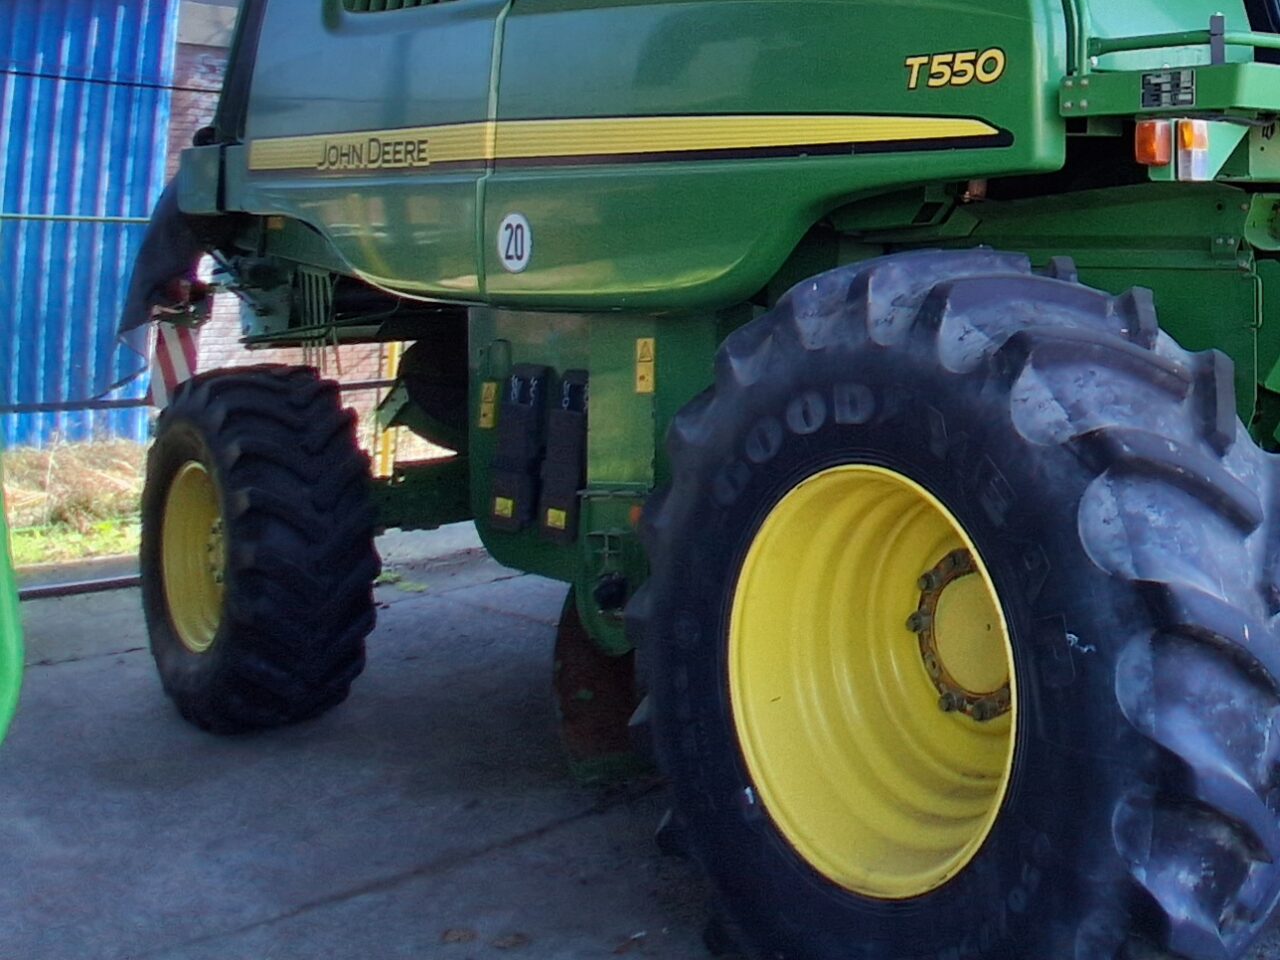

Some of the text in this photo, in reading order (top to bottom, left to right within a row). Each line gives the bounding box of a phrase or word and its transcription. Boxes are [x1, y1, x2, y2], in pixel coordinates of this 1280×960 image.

[904, 46, 1006, 90] T550
[317, 138, 428, 166] JOHN DEERE
[505, 223, 524, 261] 20
